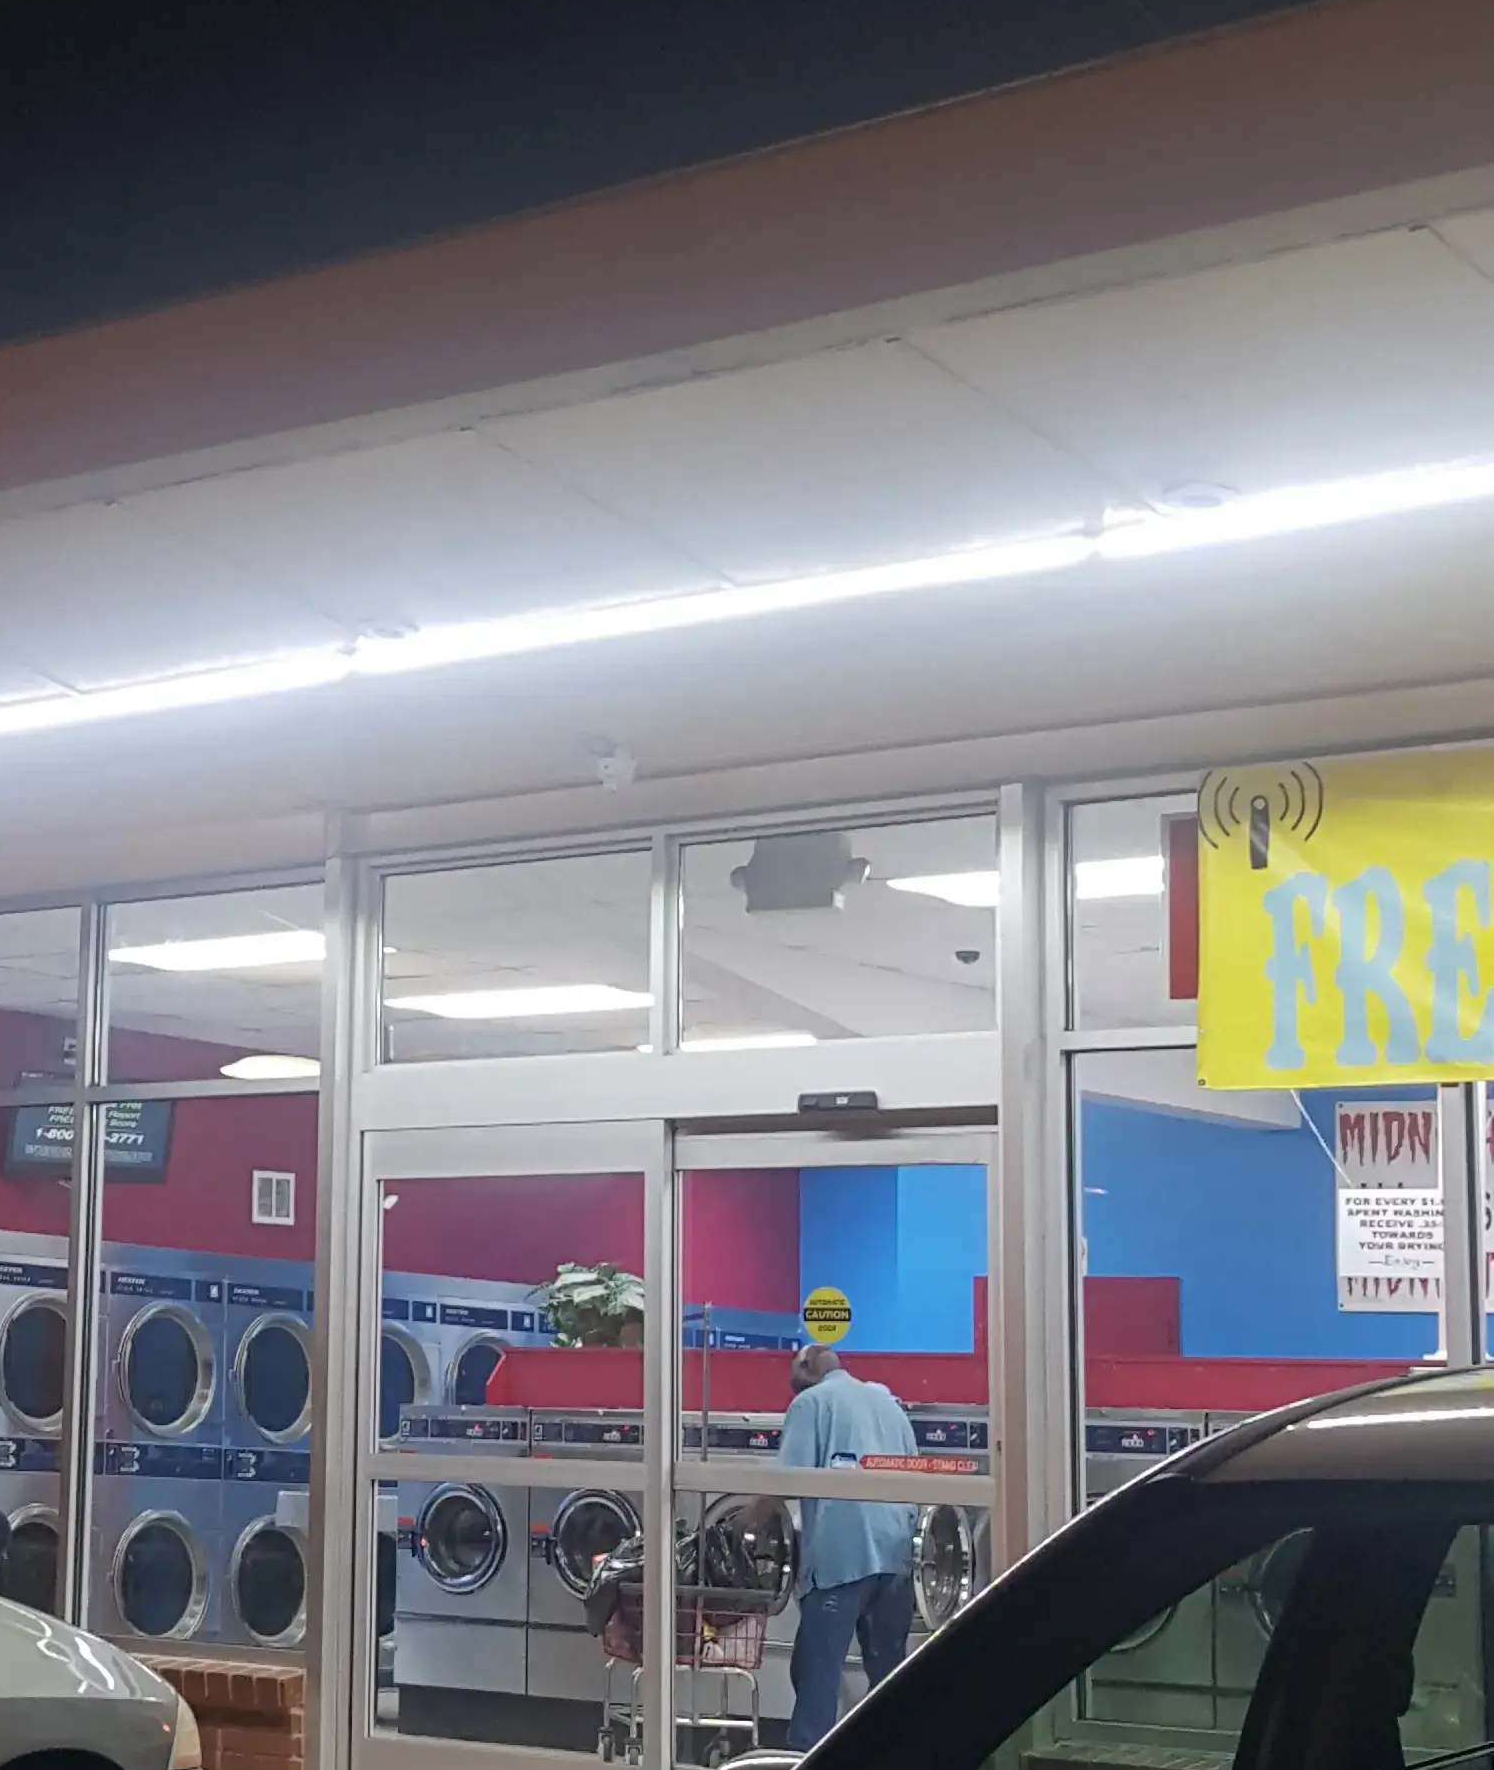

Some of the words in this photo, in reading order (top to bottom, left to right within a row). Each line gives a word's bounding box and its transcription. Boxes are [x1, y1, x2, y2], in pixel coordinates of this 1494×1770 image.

[1339, 1111, 1433, 1166] MIDN
[1344, 1197, 1371, 1206] FOR
[1375, 1197, 1417, 1206] EVERY
[1347, 1208, 1388, 1217] SPENT
[1393, 1208, 1444, 1218] WASHIN
[1359, 1219, 1414, 1228] RECEIVE
[1372, 1231, 1435, 1240] TOWARDS
[1358, 1241, 1394, 1250] YOUR
[806, 1310, 848, 1320] CAUTION
[866, 1456, 904, 1469] AUTOMATIC
[906, 1457, 928, 1470] DOOR
